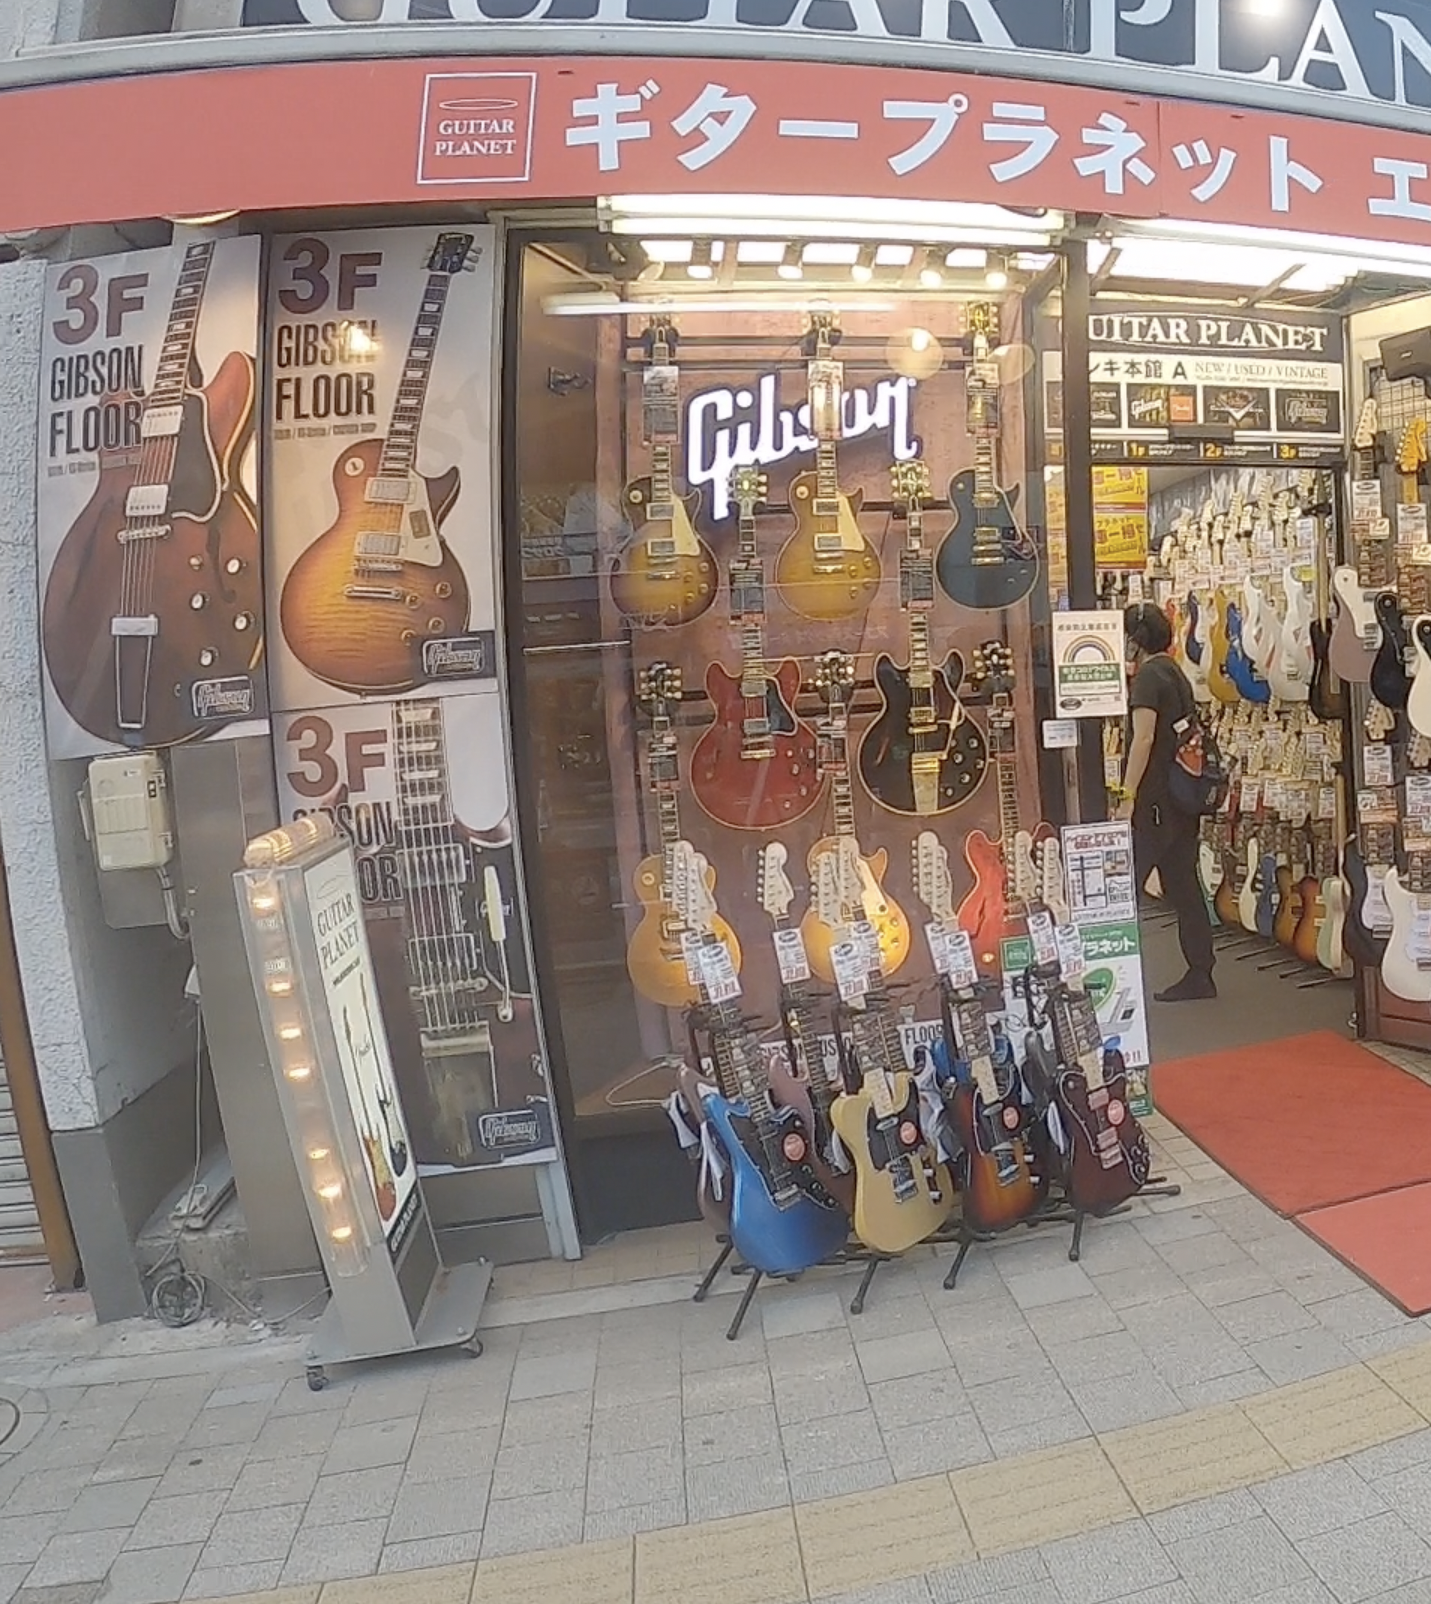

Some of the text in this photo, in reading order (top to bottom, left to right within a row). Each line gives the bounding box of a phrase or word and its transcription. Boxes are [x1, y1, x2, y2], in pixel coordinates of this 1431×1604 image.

[434, 139, 517, 157] PLANET
[438, 118, 515, 136] GUITAR
[566, 78, 1323, 213] ギタープラネット
[278, 238, 384, 315] 3F
[53, 264, 150, 346] 3F
[1089, 314, 1329, 353] UITAR PLANET
[50, 343, 145, 402] GIBSON
[1171, 360, 1188, 380] A
[1275, 366, 1328, 380] VINTAGE
[275, 372, 377, 421] FLOOR
[48, 400, 144, 457] FLOOR
[286, 715, 388, 798] 3F
[317, 893, 355, 937] GUITAR
[320, 920, 360, 970] PLANET
[1082, 936, 1135, 957] ラネット
